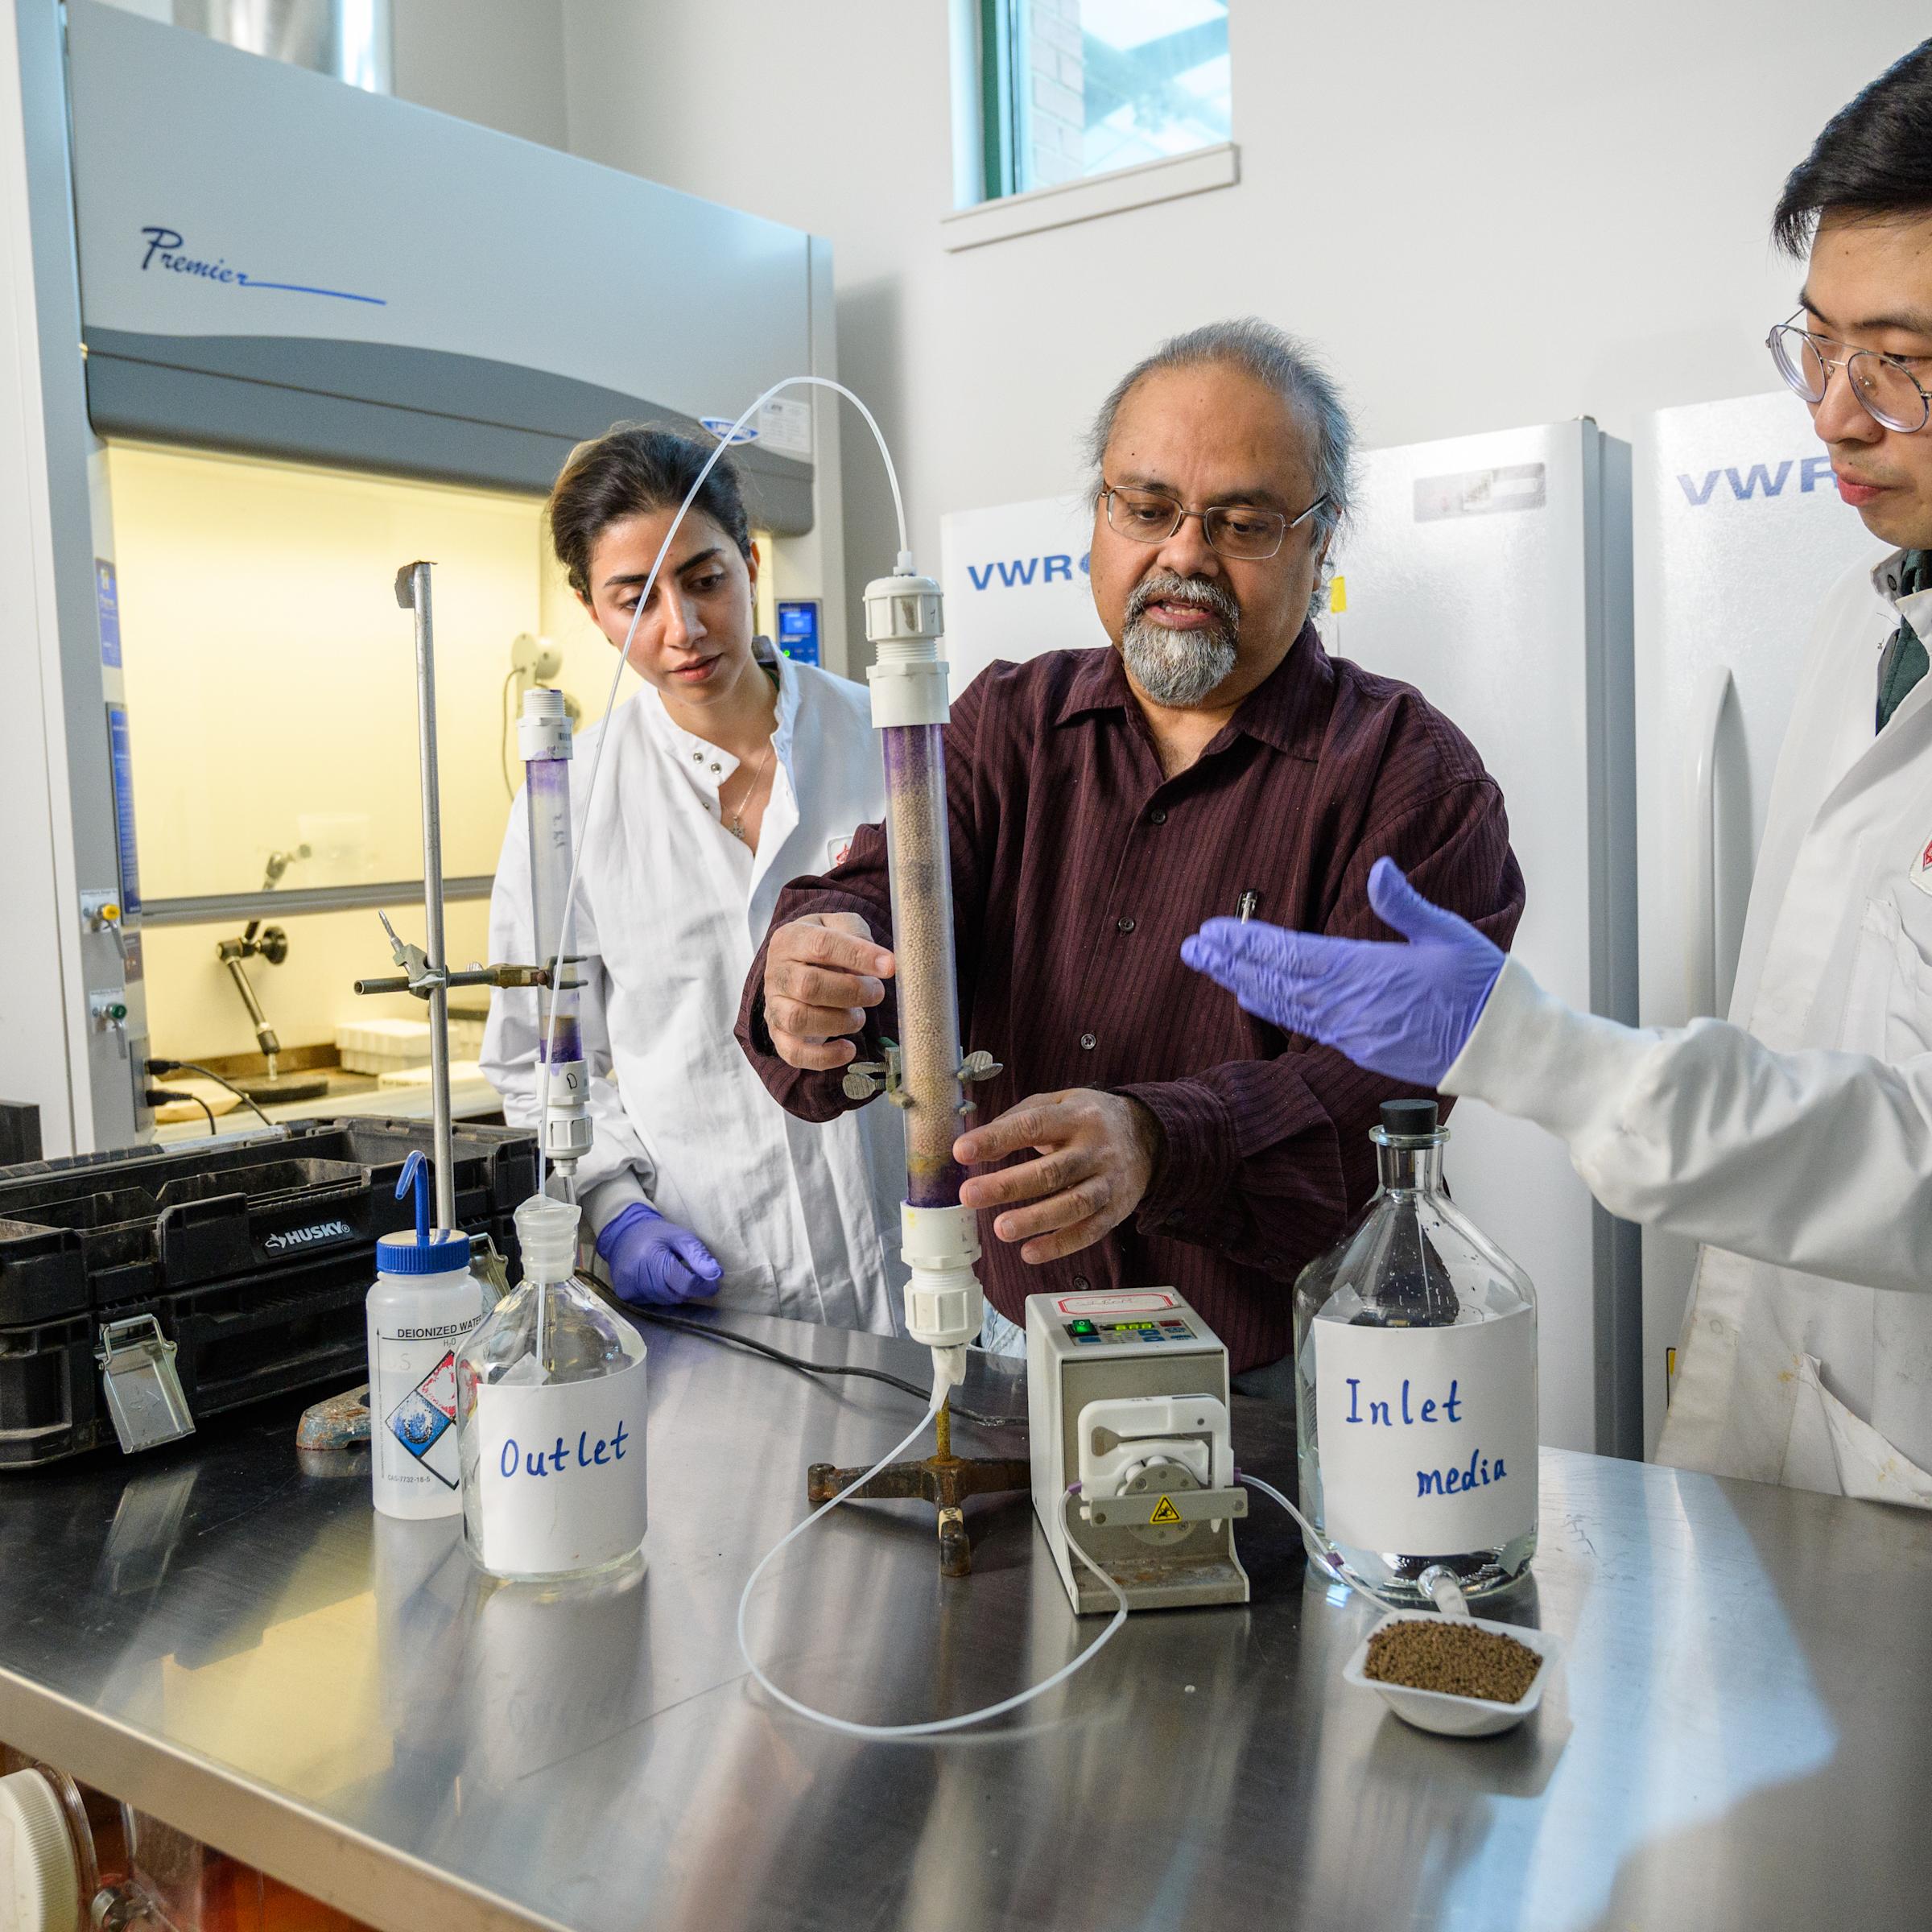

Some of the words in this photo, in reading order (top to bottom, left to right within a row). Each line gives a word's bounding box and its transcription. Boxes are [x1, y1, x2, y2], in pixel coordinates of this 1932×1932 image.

[141, 226, 248, 285] Premier
[967, 554, 1073, 591] VWR
[397, 1324, 457, 1338] DEIONIZED
[1345, 1378, 1462, 1426] Inlet
[501, 1420, 629, 1478] Outlet
[1416, 1448, 1508, 1497] media
